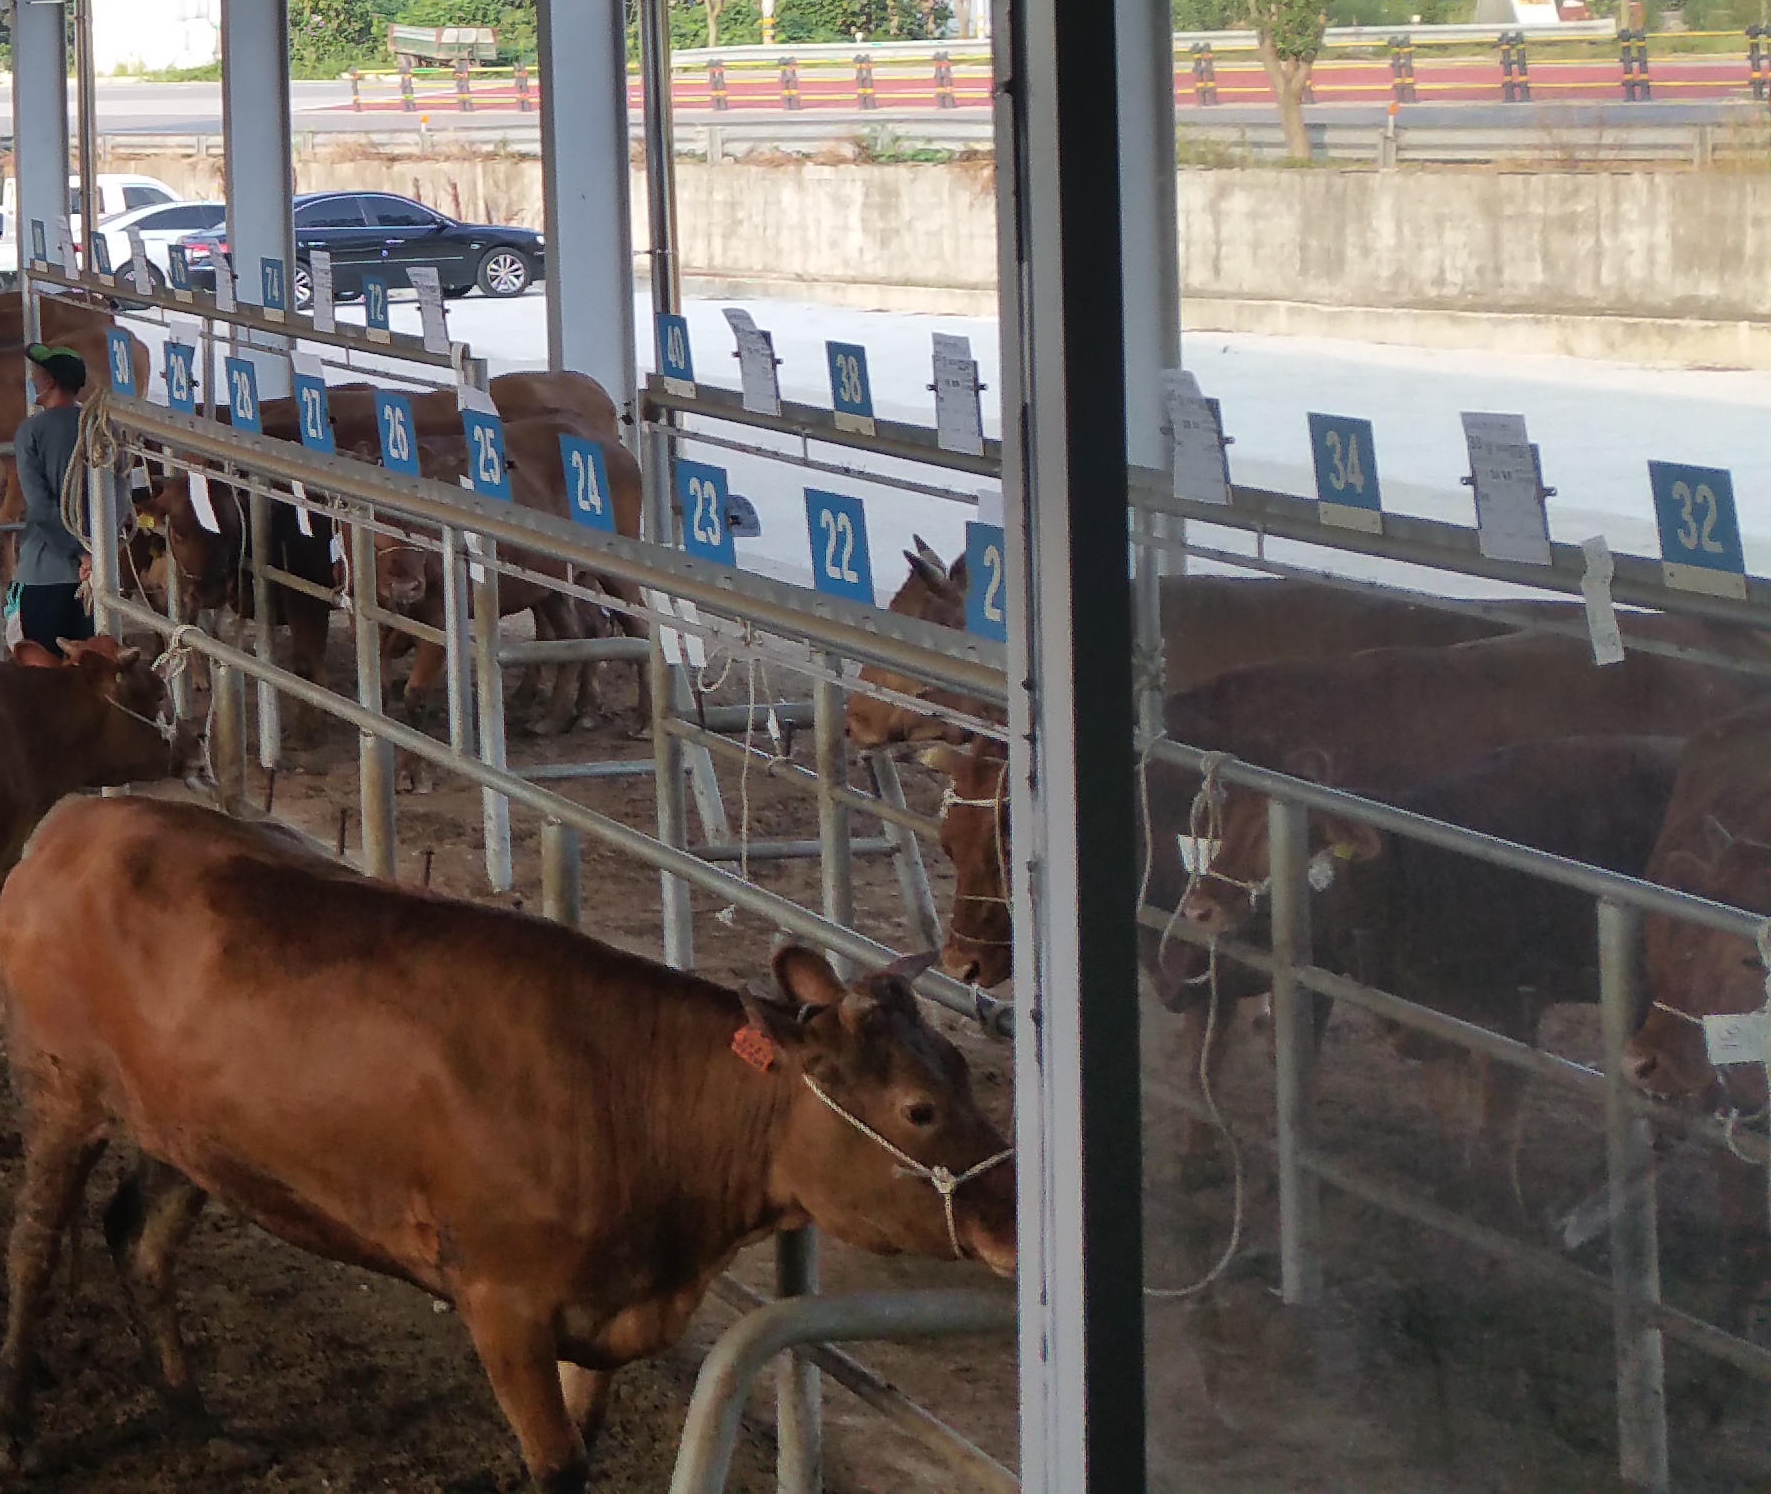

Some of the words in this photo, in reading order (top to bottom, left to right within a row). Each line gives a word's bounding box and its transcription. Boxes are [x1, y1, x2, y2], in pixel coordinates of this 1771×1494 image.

[113, 337, 130, 385] 30
[170, 353, 188, 401] 29
[667, 325, 686, 370] 40
[232, 369, 254, 421] 28
[835, 354, 862, 404] 38
[301, 386, 324, 440] 27
[383, 404, 409, 462] 26
[473, 424, 501, 486] 25
[571, 450, 602, 515] 24
[1325, 429, 1365, 494] 34
[689, 476, 722, 547] 23
[1670, 479, 1724, 554] 32
[819, 507, 859, 585] 22
[983, 544, 1003, 623] 2
